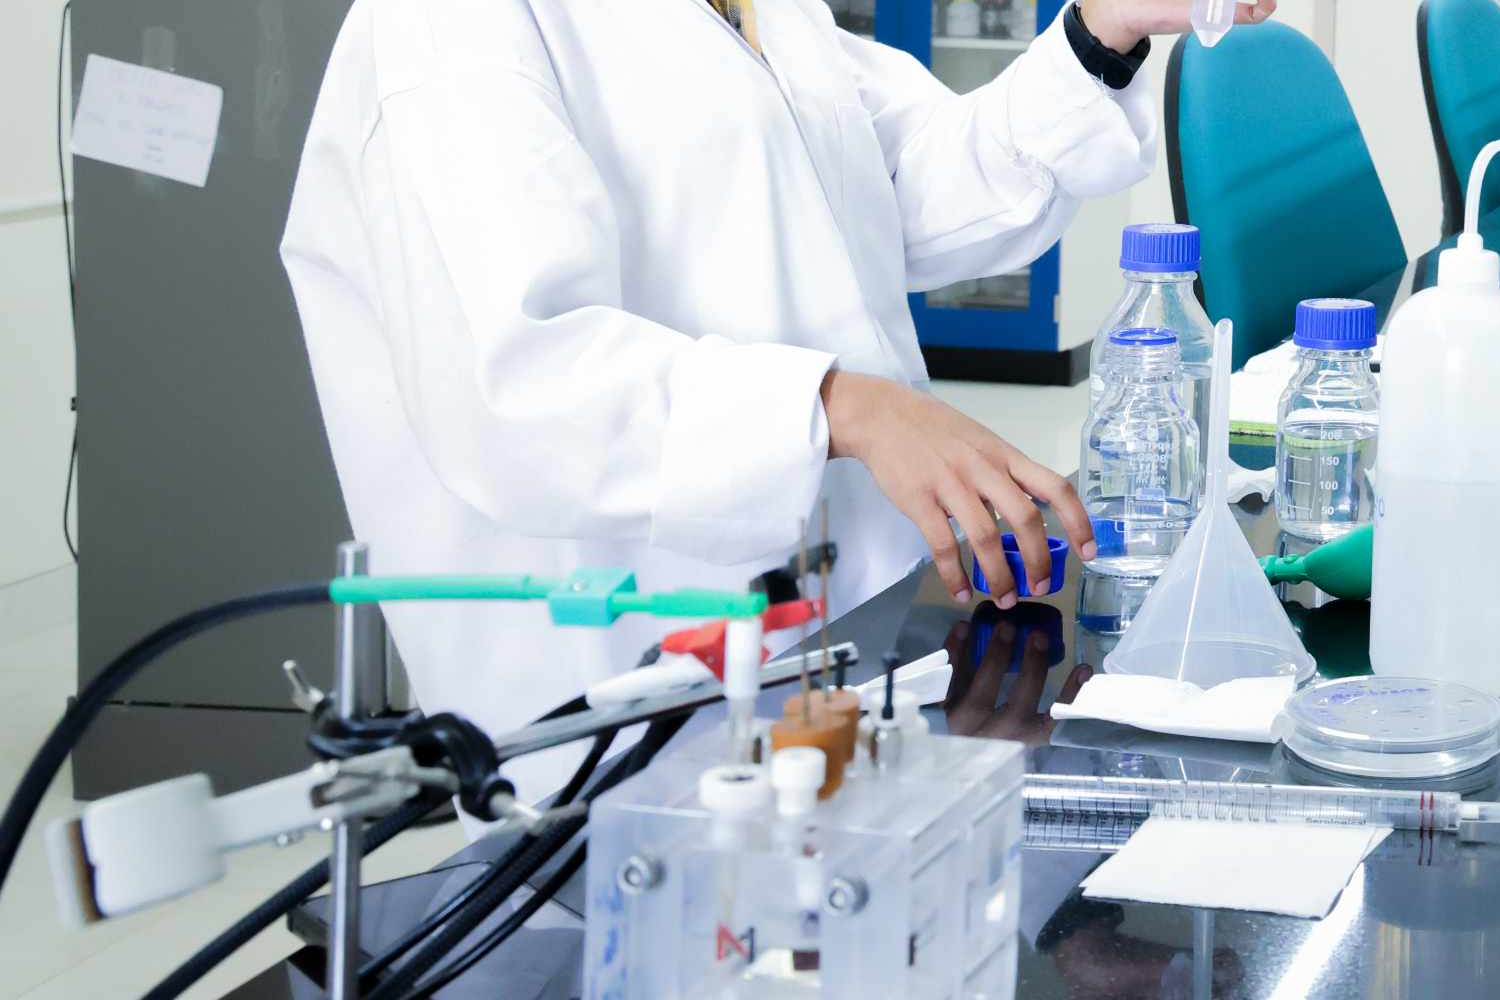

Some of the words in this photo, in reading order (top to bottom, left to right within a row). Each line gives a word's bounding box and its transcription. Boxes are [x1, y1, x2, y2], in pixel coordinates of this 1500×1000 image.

[1320, 456, 1340, 466] 150
[1319, 480, 1339, 490] 100
[1320, 505, 1335, 515] 50
